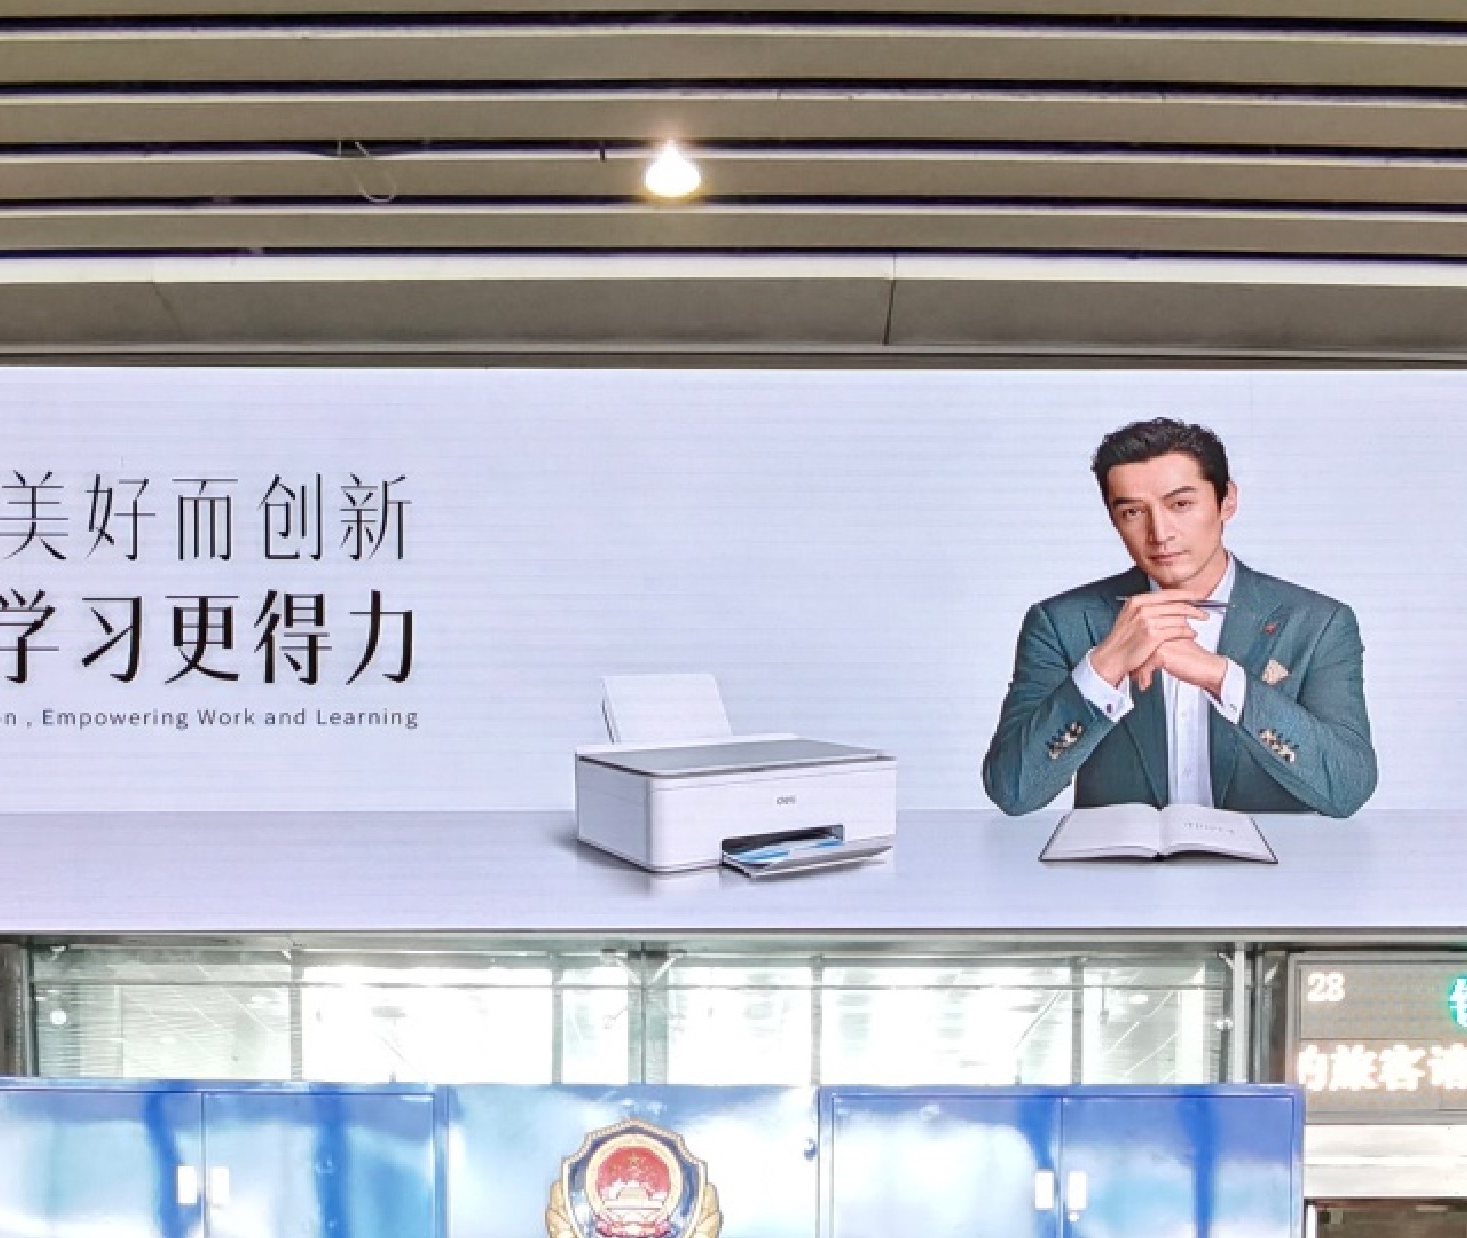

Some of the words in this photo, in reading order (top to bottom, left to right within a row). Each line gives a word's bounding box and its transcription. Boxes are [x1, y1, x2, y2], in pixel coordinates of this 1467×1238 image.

[42, 708, 188, 730] Empowering
[197, 708, 255, 726] Work
[264, 708, 306, 726] and
[317, 708, 419, 730] Learning
